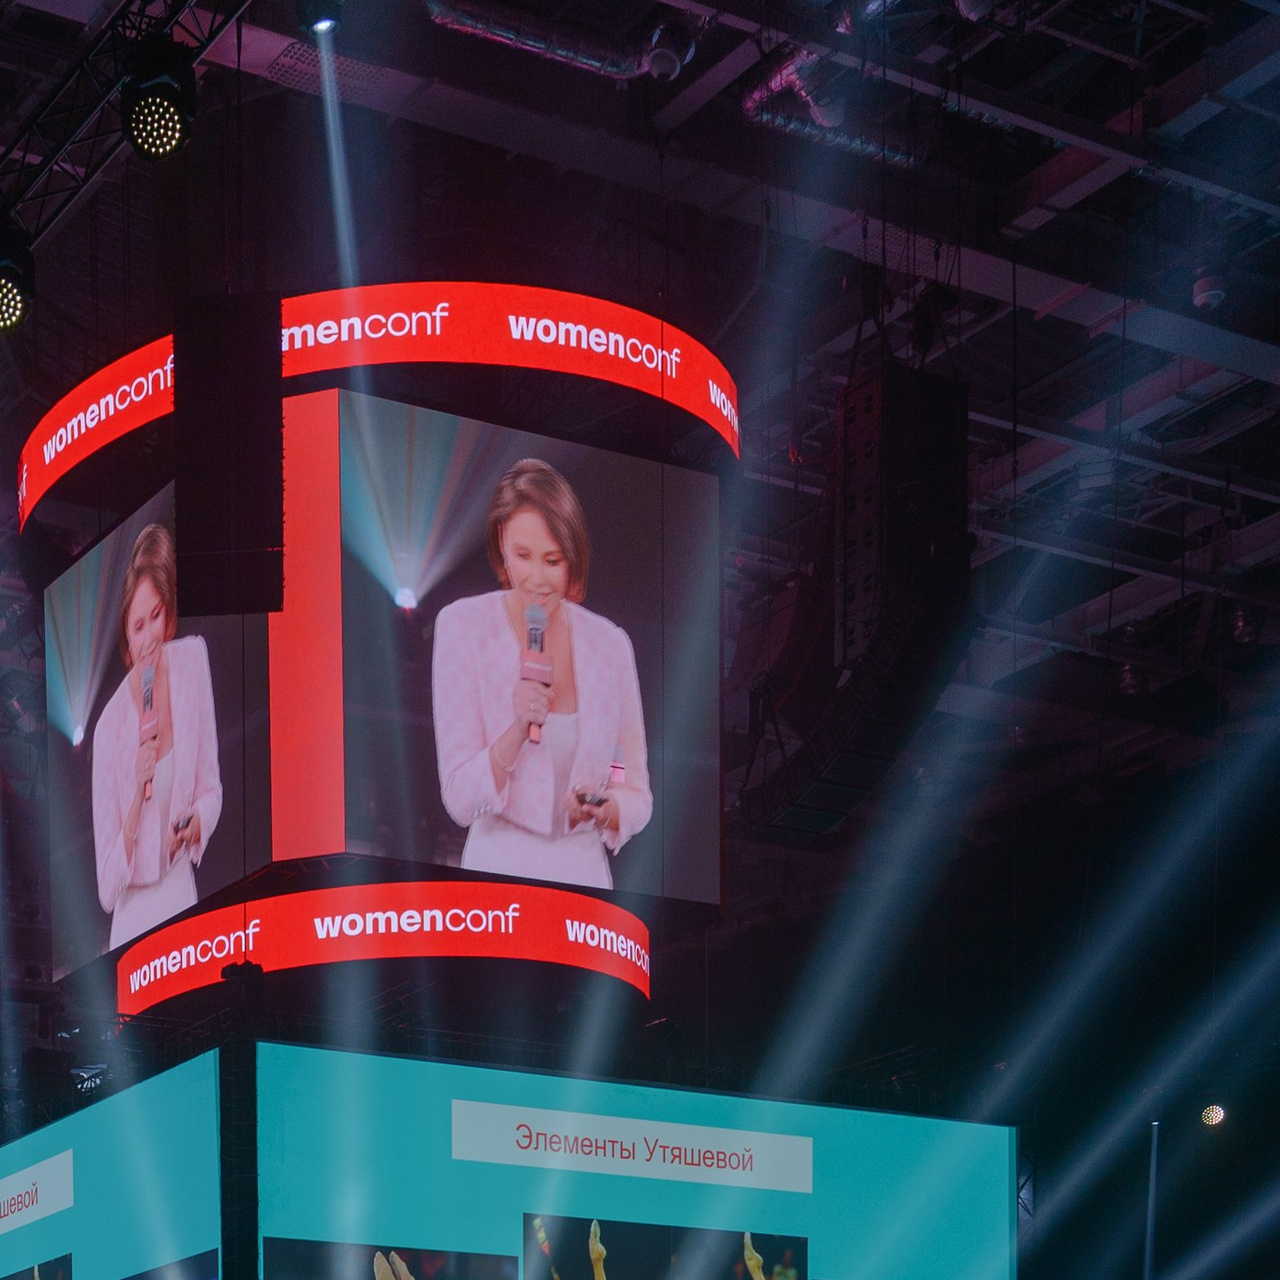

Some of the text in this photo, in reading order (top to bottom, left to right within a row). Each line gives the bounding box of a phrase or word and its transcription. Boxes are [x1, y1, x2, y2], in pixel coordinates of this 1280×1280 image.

[43, 354, 174, 465] womenconf
[508, 314, 680, 379] womenconf
[129, 920, 260, 994] womenconf
[314, 903, 520, 939] womenconf
[516, 1123, 754, 1172] Элементы Утяшевой
